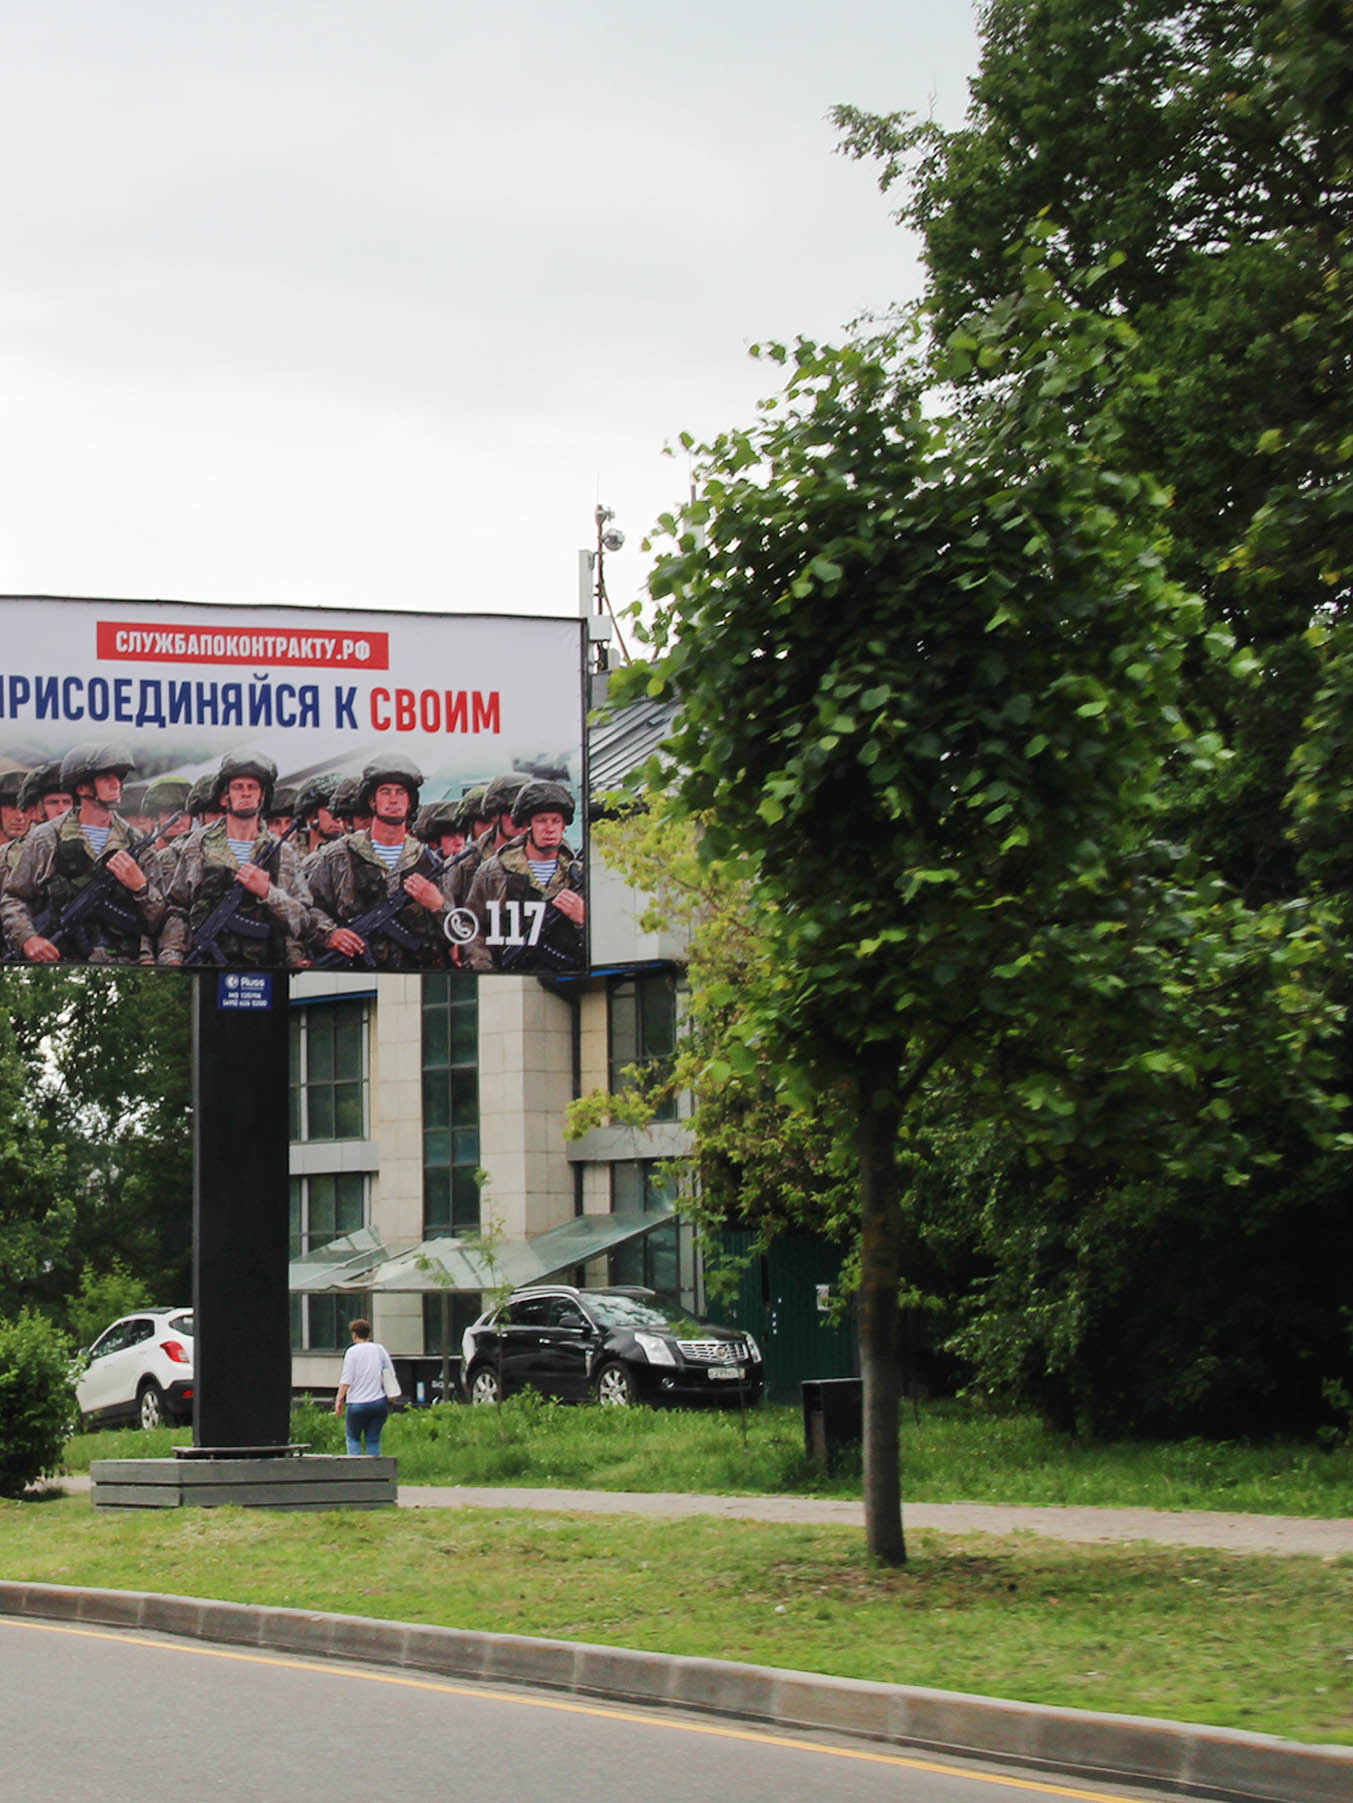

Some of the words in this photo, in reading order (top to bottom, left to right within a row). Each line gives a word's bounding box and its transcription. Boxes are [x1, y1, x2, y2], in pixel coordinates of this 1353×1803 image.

[115, 629, 371, 662] СЛУЖБАПОКОНТРАКТУ.РФ
[336, 686, 358, 729] К
[369, 686, 501, 734] СВОИМ
[485, 900, 547, 947] 117
